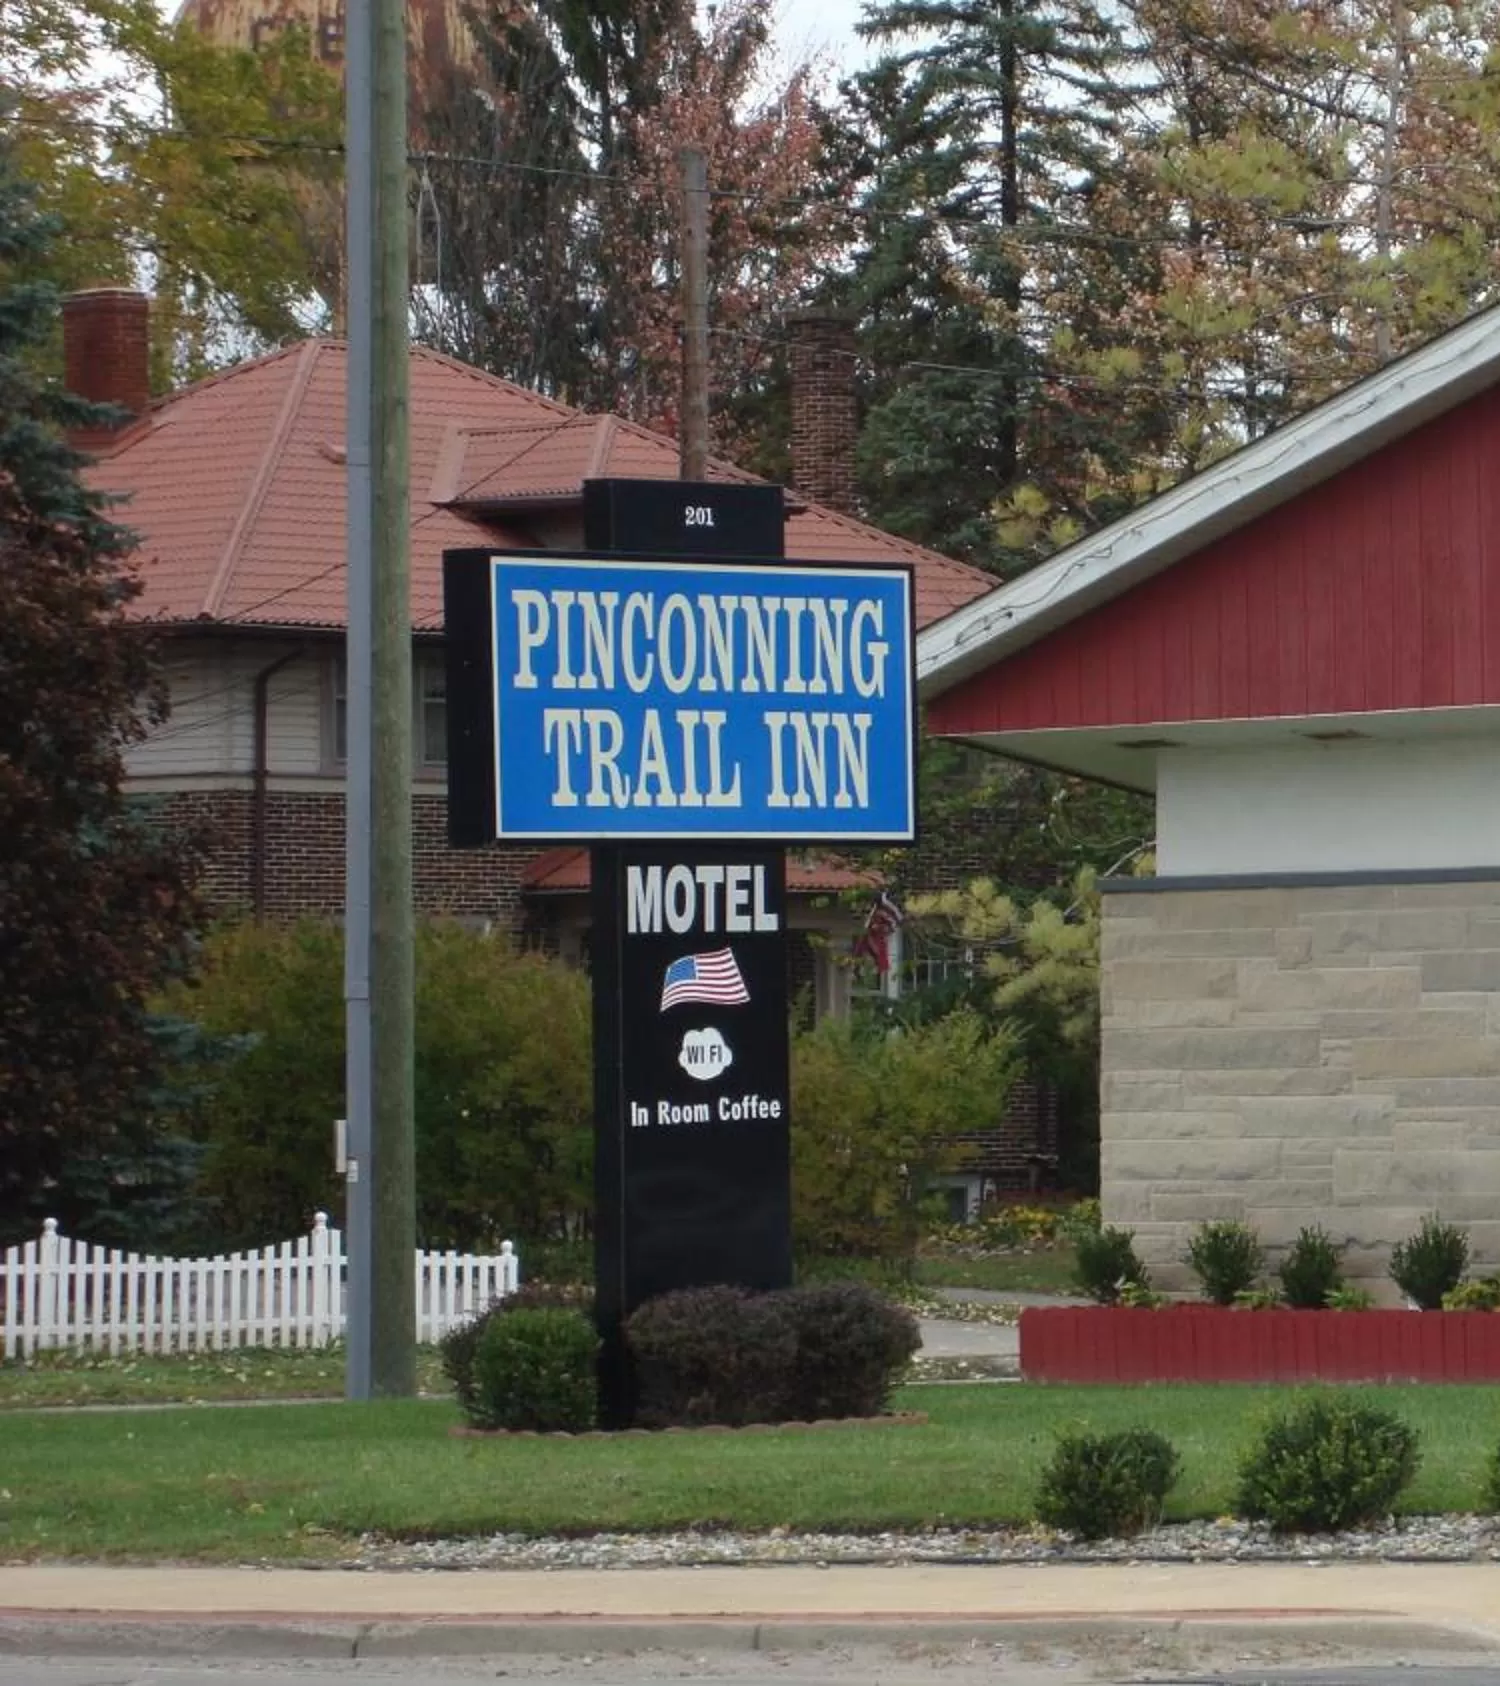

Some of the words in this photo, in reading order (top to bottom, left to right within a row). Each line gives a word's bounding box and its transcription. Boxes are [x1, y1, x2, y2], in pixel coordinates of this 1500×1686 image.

[684, 506, 714, 527] 201
[511, 589, 889, 698] PINCONNING
[543, 708, 742, 809] TRAIL
[764, 711, 872, 809] INN
[627, 864, 779, 933] MOTEL
[686, 1045, 705, 1064] WI
[709, 1044, 723, 1063] FI
[631, 1101, 648, 1126] In
[657, 1100, 710, 1124] Room
[718, 1094, 781, 1121] Coffee
